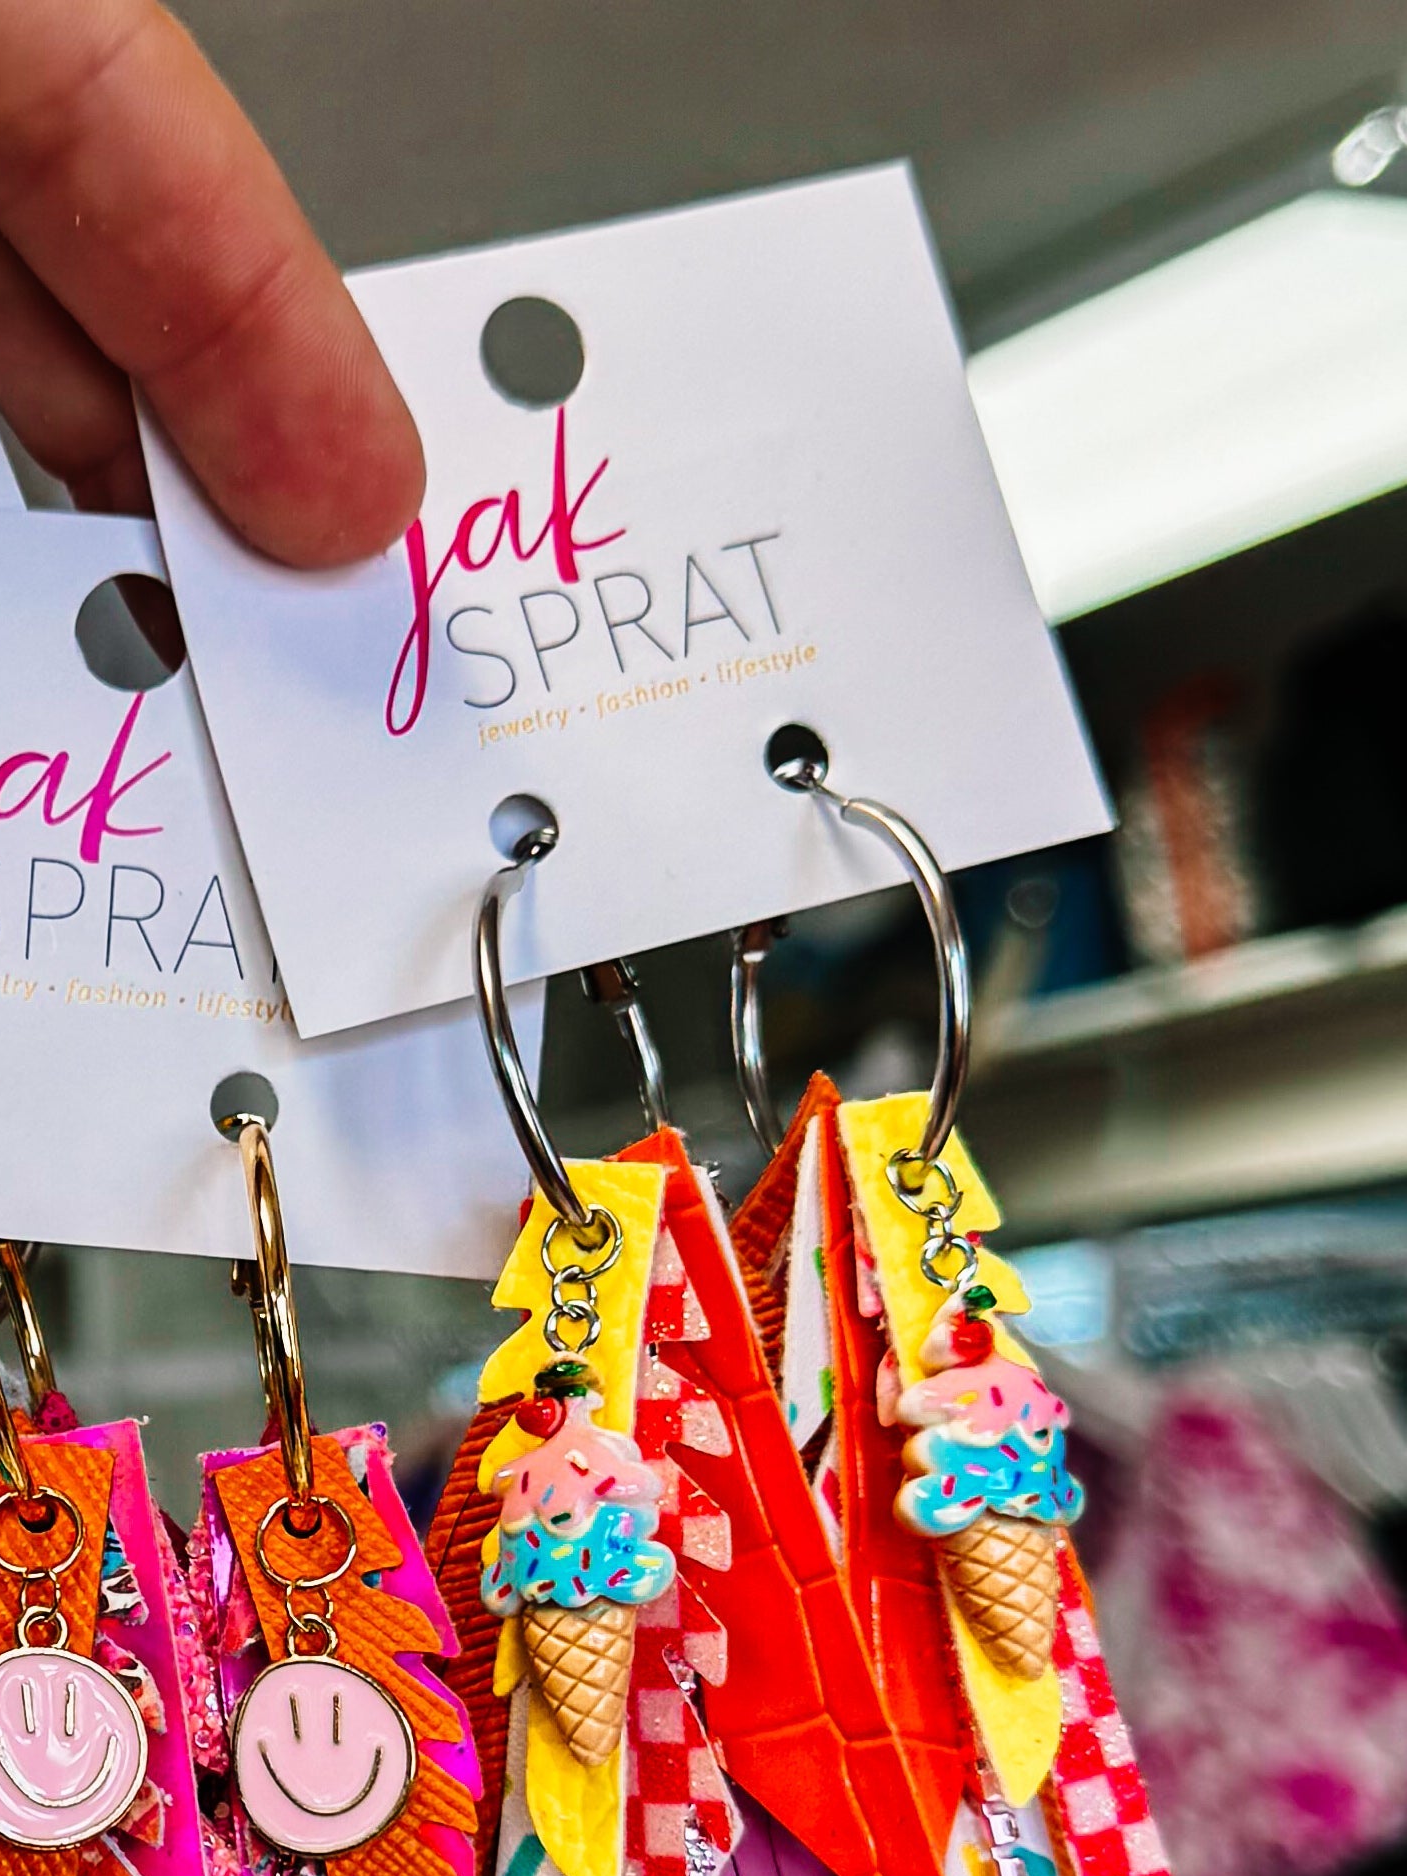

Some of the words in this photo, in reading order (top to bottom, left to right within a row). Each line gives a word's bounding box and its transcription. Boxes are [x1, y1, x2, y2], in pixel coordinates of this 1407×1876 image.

[386, 405, 625, 737] jak
[444, 532, 782, 710] SPRAT
[478, 706, 569, 750] jewelry
[596, 675, 691, 718] fashion
[716, 644, 818, 686] lifestyle
[65, 977, 167, 1009] fashion
[196, 990, 296, 1025] lifestyl
